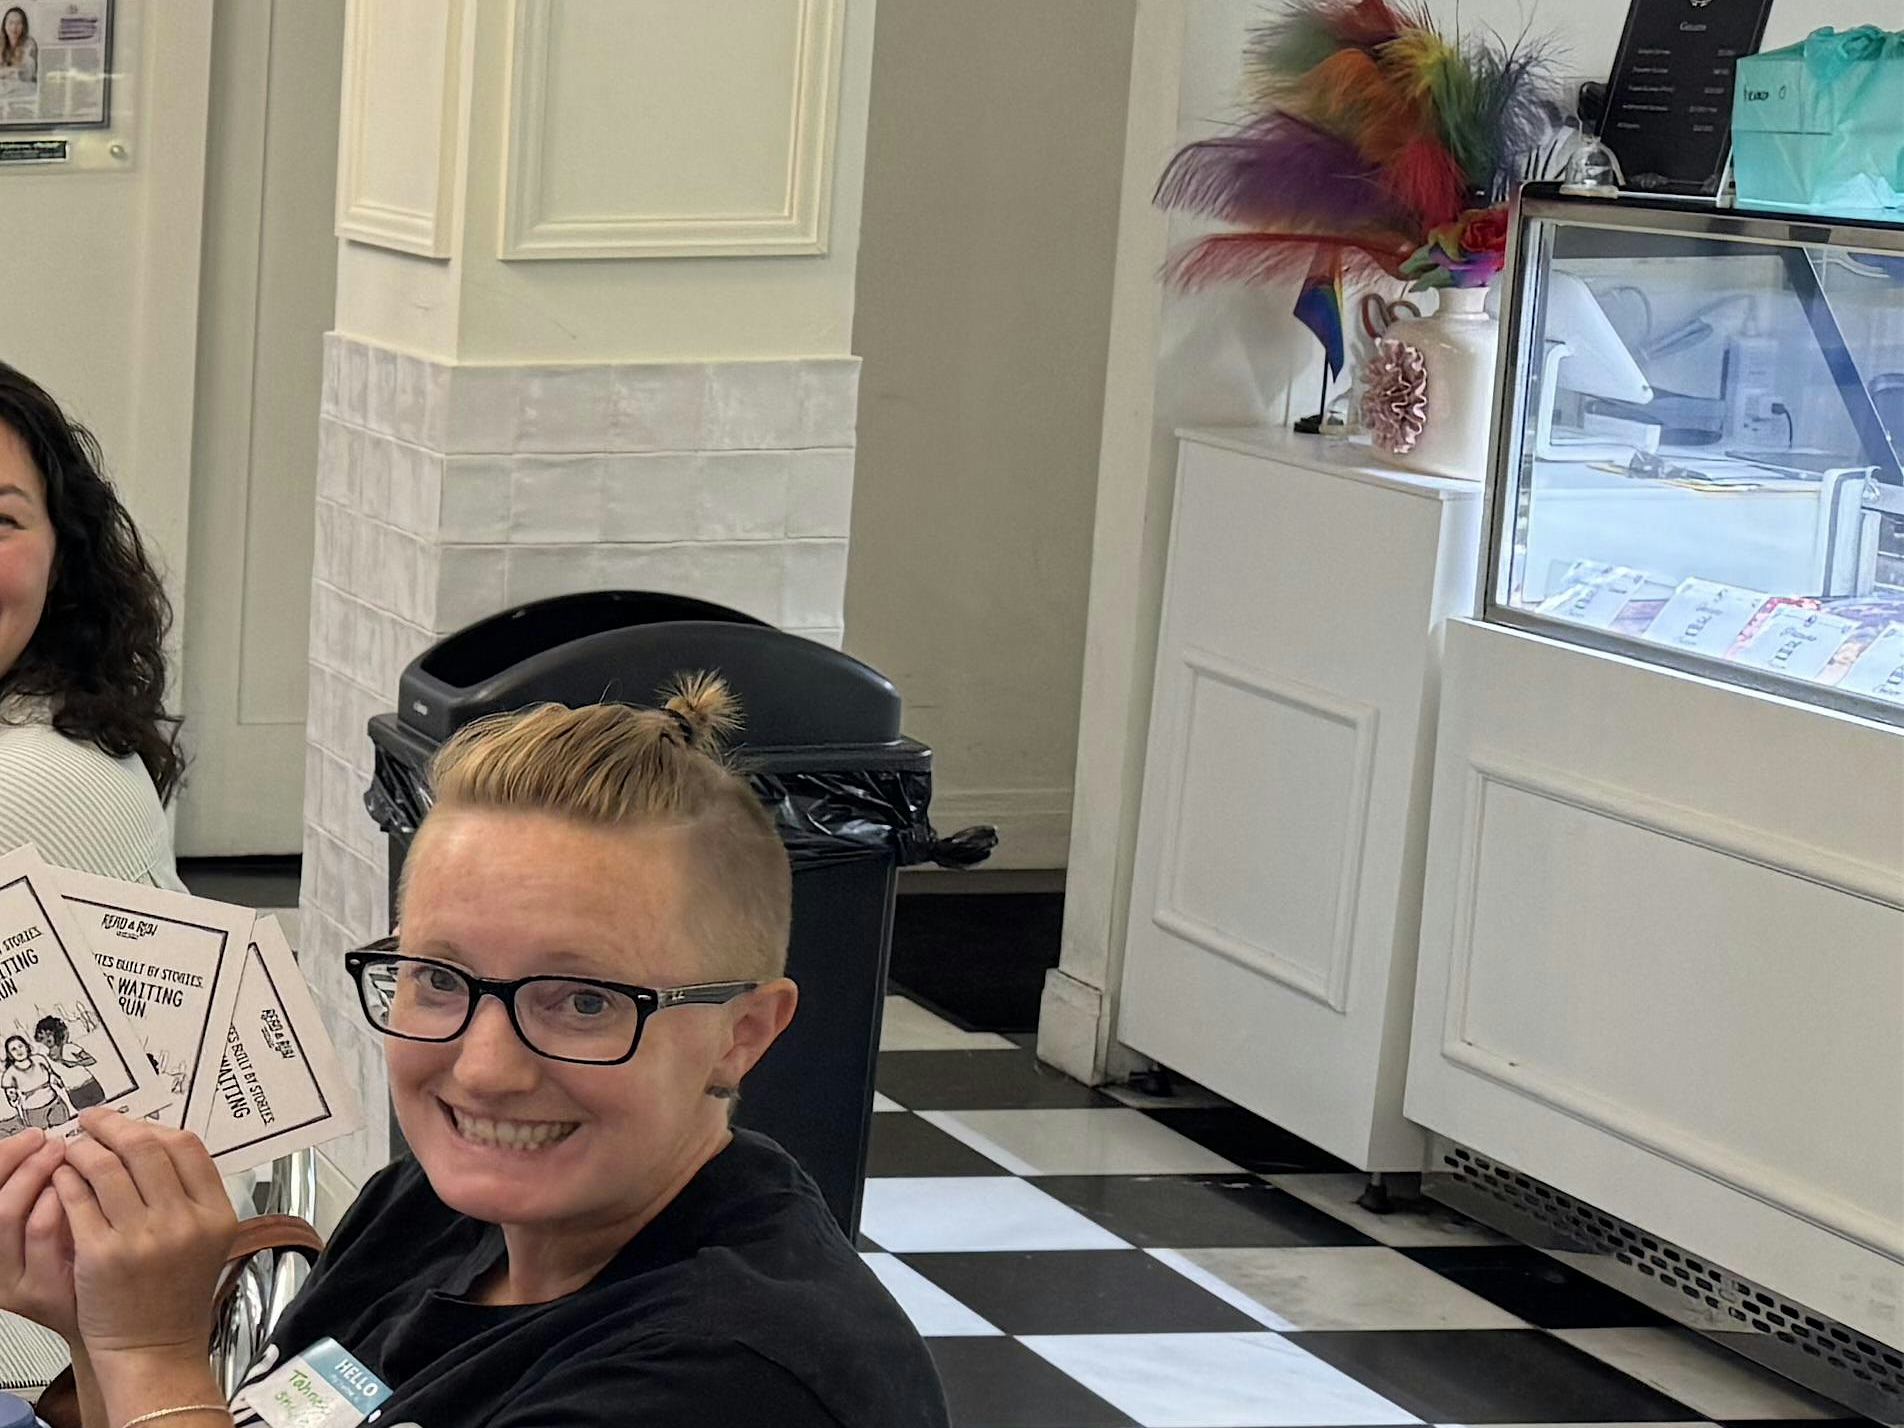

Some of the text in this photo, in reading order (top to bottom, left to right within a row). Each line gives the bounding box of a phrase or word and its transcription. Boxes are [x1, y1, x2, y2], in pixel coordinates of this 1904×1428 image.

[116, 958, 145, 975] BUILT
[147, 965, 160, 978] BY
[118, 977, 184, 1007] WAITING
[230, 1043, 253, 1071] BUILT
[334, 1358, 379, 1397] HELLO
